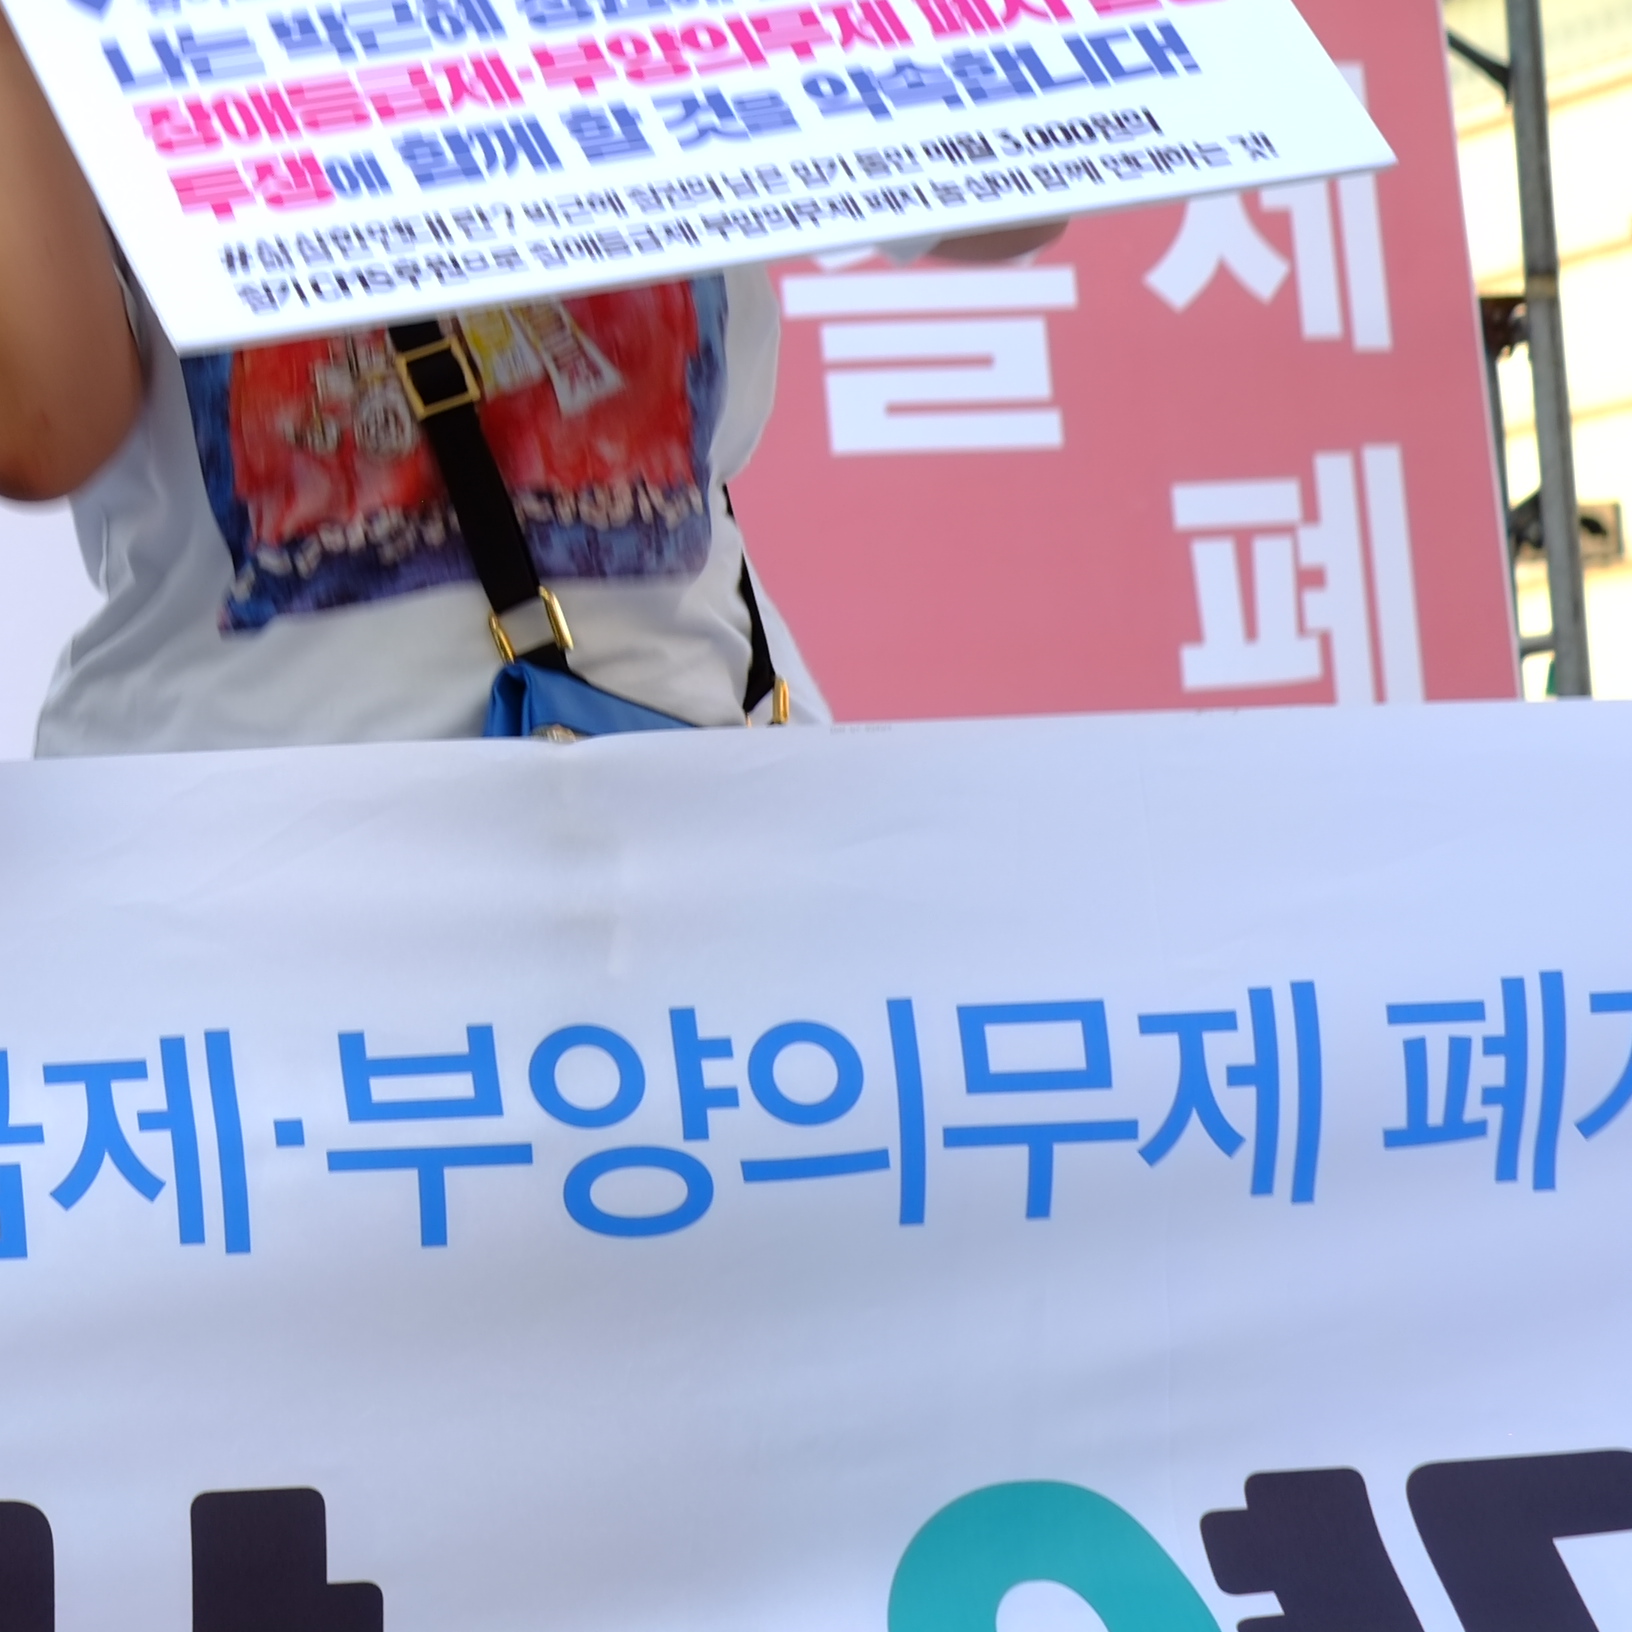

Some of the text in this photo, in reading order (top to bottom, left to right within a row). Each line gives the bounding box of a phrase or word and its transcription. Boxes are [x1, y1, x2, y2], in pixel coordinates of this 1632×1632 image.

[101, 25, 266, 93] 나는
[169, 19, 1201, 221] 투쟁에 함께 할 것을 약속합니다!
